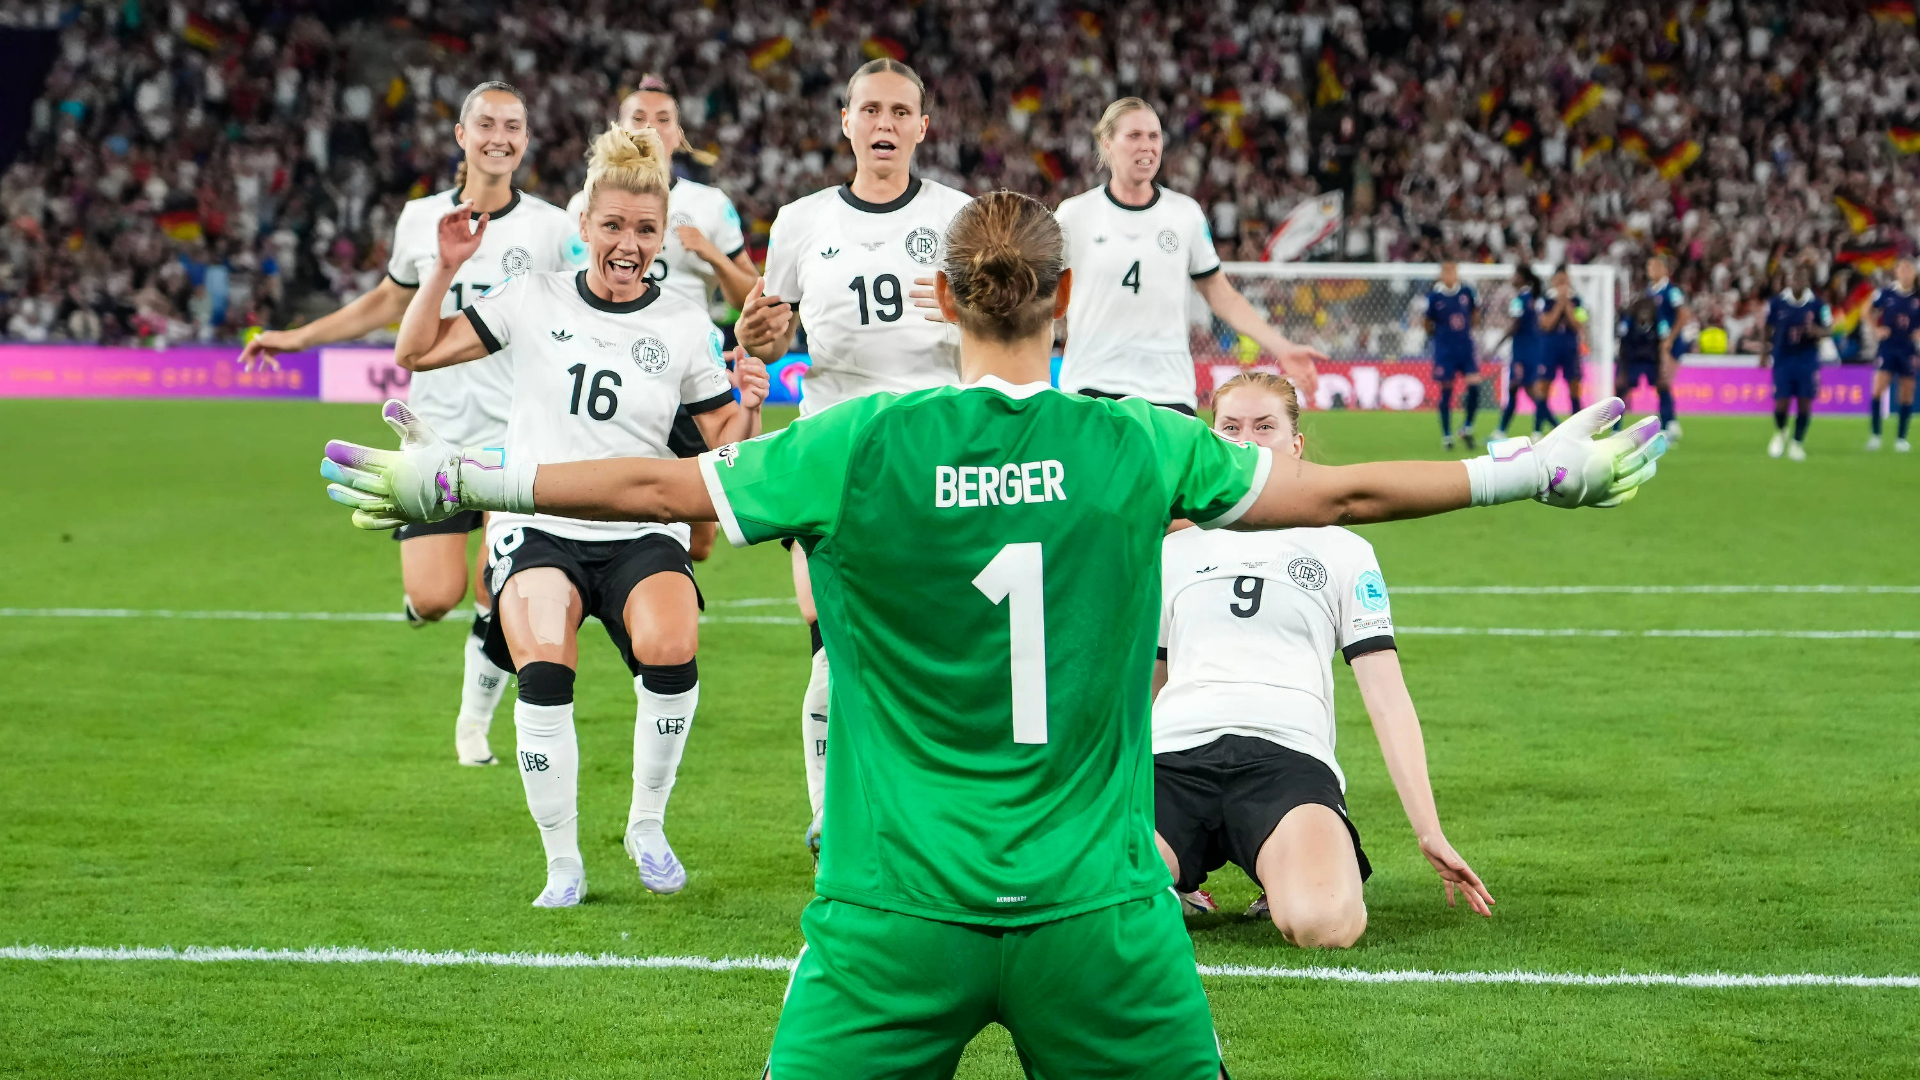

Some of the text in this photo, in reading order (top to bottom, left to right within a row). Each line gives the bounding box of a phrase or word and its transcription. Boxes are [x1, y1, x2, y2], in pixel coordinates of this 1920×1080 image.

[848, 273, 904, 326] 19
[1121, 260, 1141, 295] 4
[368, 365, 410, 395] yu
[567, 362, 623, 421] 16
[1818, 384, 1864, 405] UTE
[935, 459, 1067, 508] BERGER
[1229, 575, 1264, 618] 9
[971, 541, 1048, 744] 1
